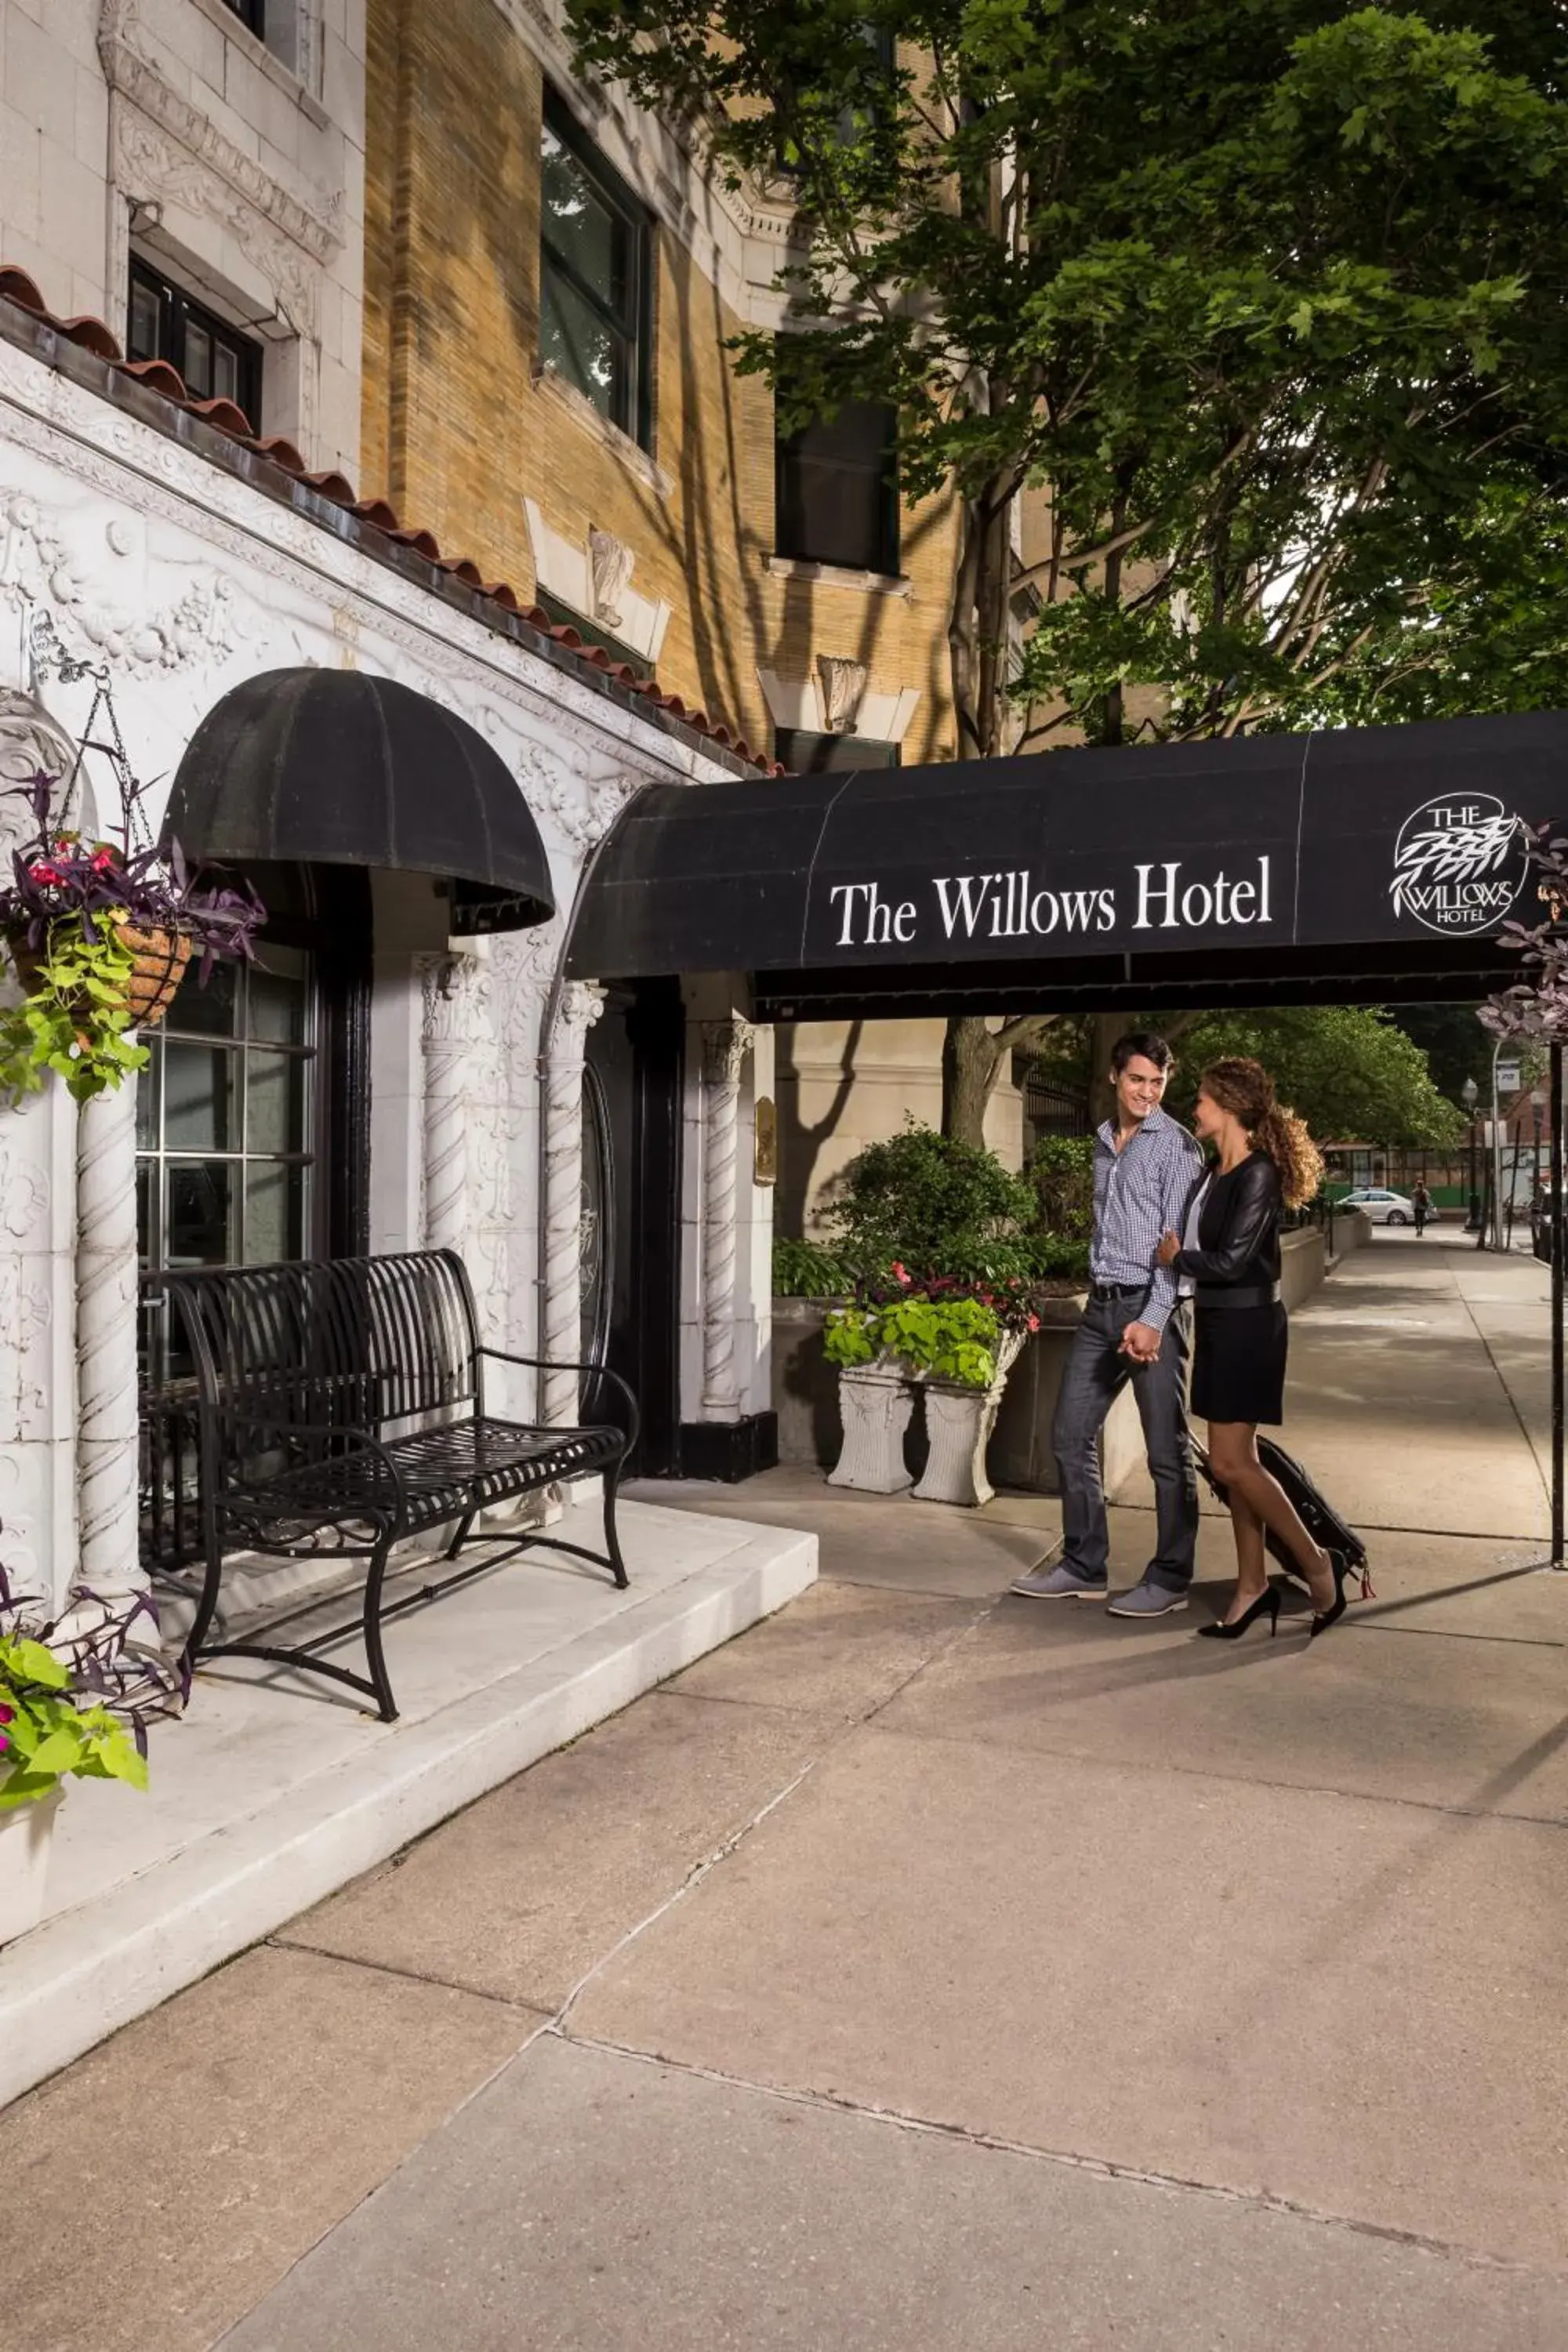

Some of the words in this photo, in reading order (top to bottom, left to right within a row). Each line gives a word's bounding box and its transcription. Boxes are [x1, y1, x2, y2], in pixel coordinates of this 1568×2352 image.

[1427, 805, 1480, 827] THE
[829, 882, 916, 946] The
[931, 870, 1116, 939] Willows
[1131, 855, 1272, 929] Hotel
[1404, 880, 1514, 911] WILLOWS
[1436, 909, 1487, 924] HOTEL
